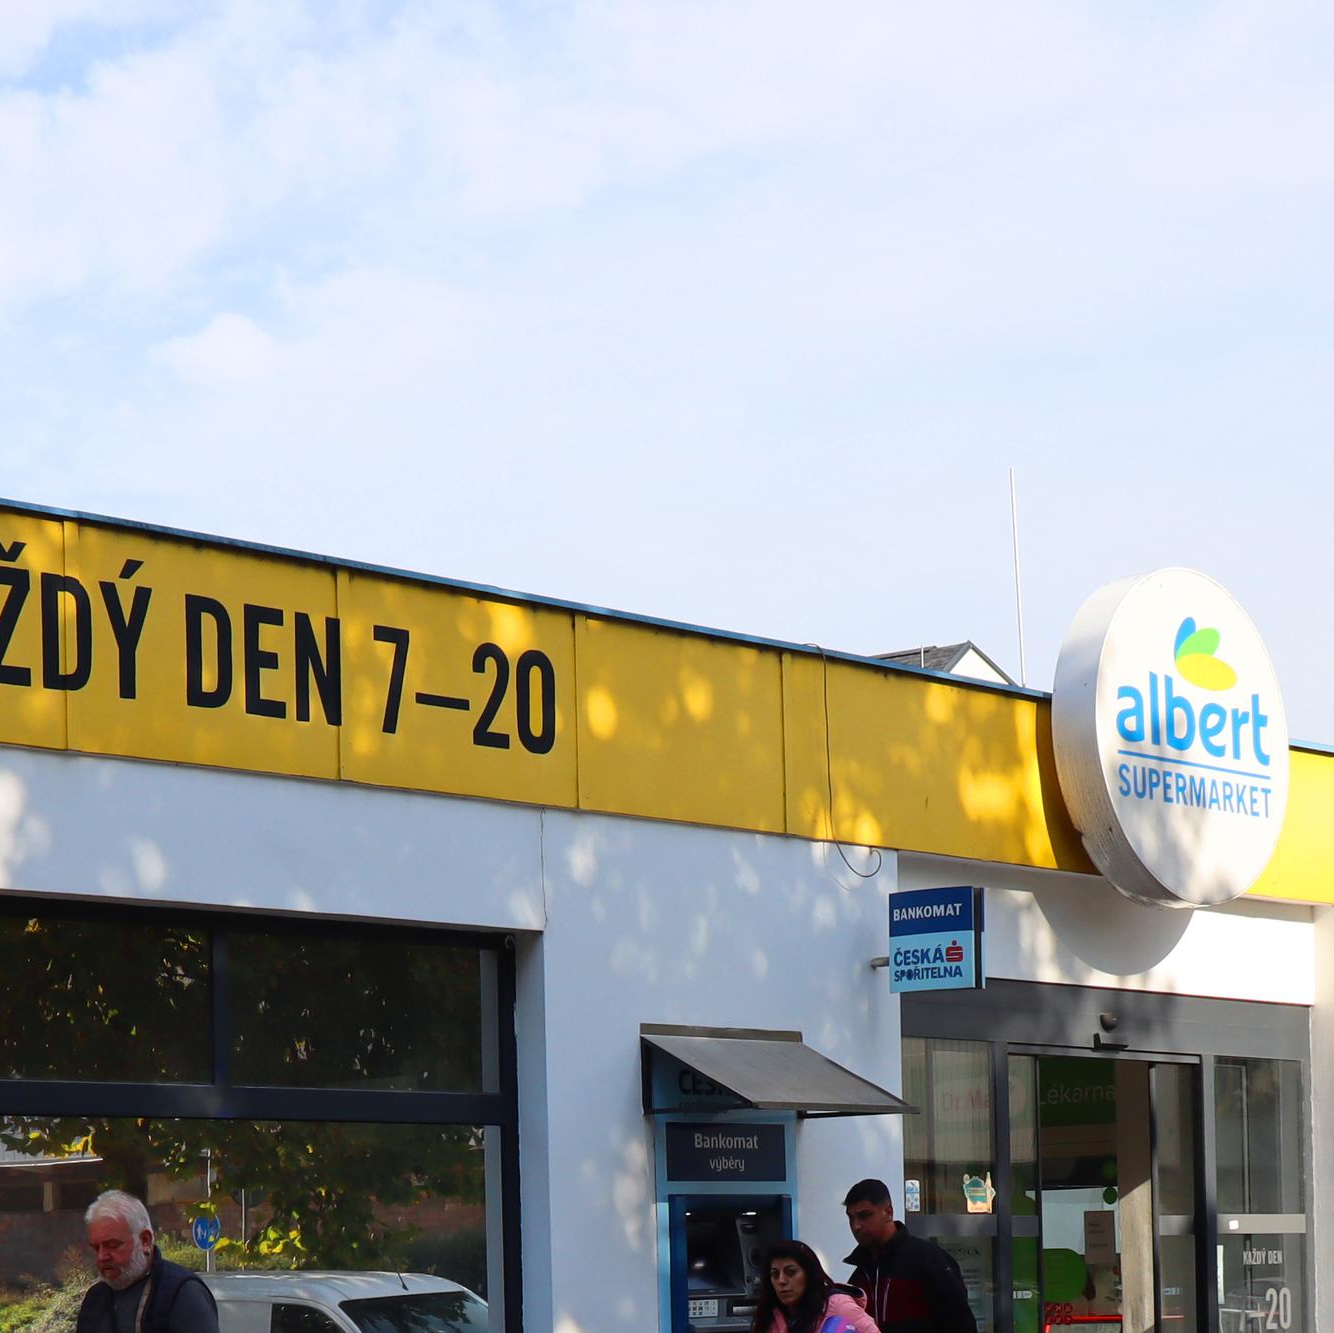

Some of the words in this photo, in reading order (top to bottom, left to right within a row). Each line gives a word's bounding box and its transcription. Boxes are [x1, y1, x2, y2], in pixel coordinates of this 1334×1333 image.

[185, 593, 343, 726] DEN
[1116, 671, 1271, 766] albert
[1118, 763, 1272, 818] SUPERMARKET
[893, 903, 963, 922] BANKOMAT
[894, 944, 945, 966] ČESKÁ
[894, 966, 963, 982] SPOŘITELNA
[694, 1132, 759, 1151] Bankomat
[710, 1156, 745, 1172] výběry
[1243, 1248, 1267, 1265] KAŽDÝ
[1268, 1251, 1283, 1265] DEN
